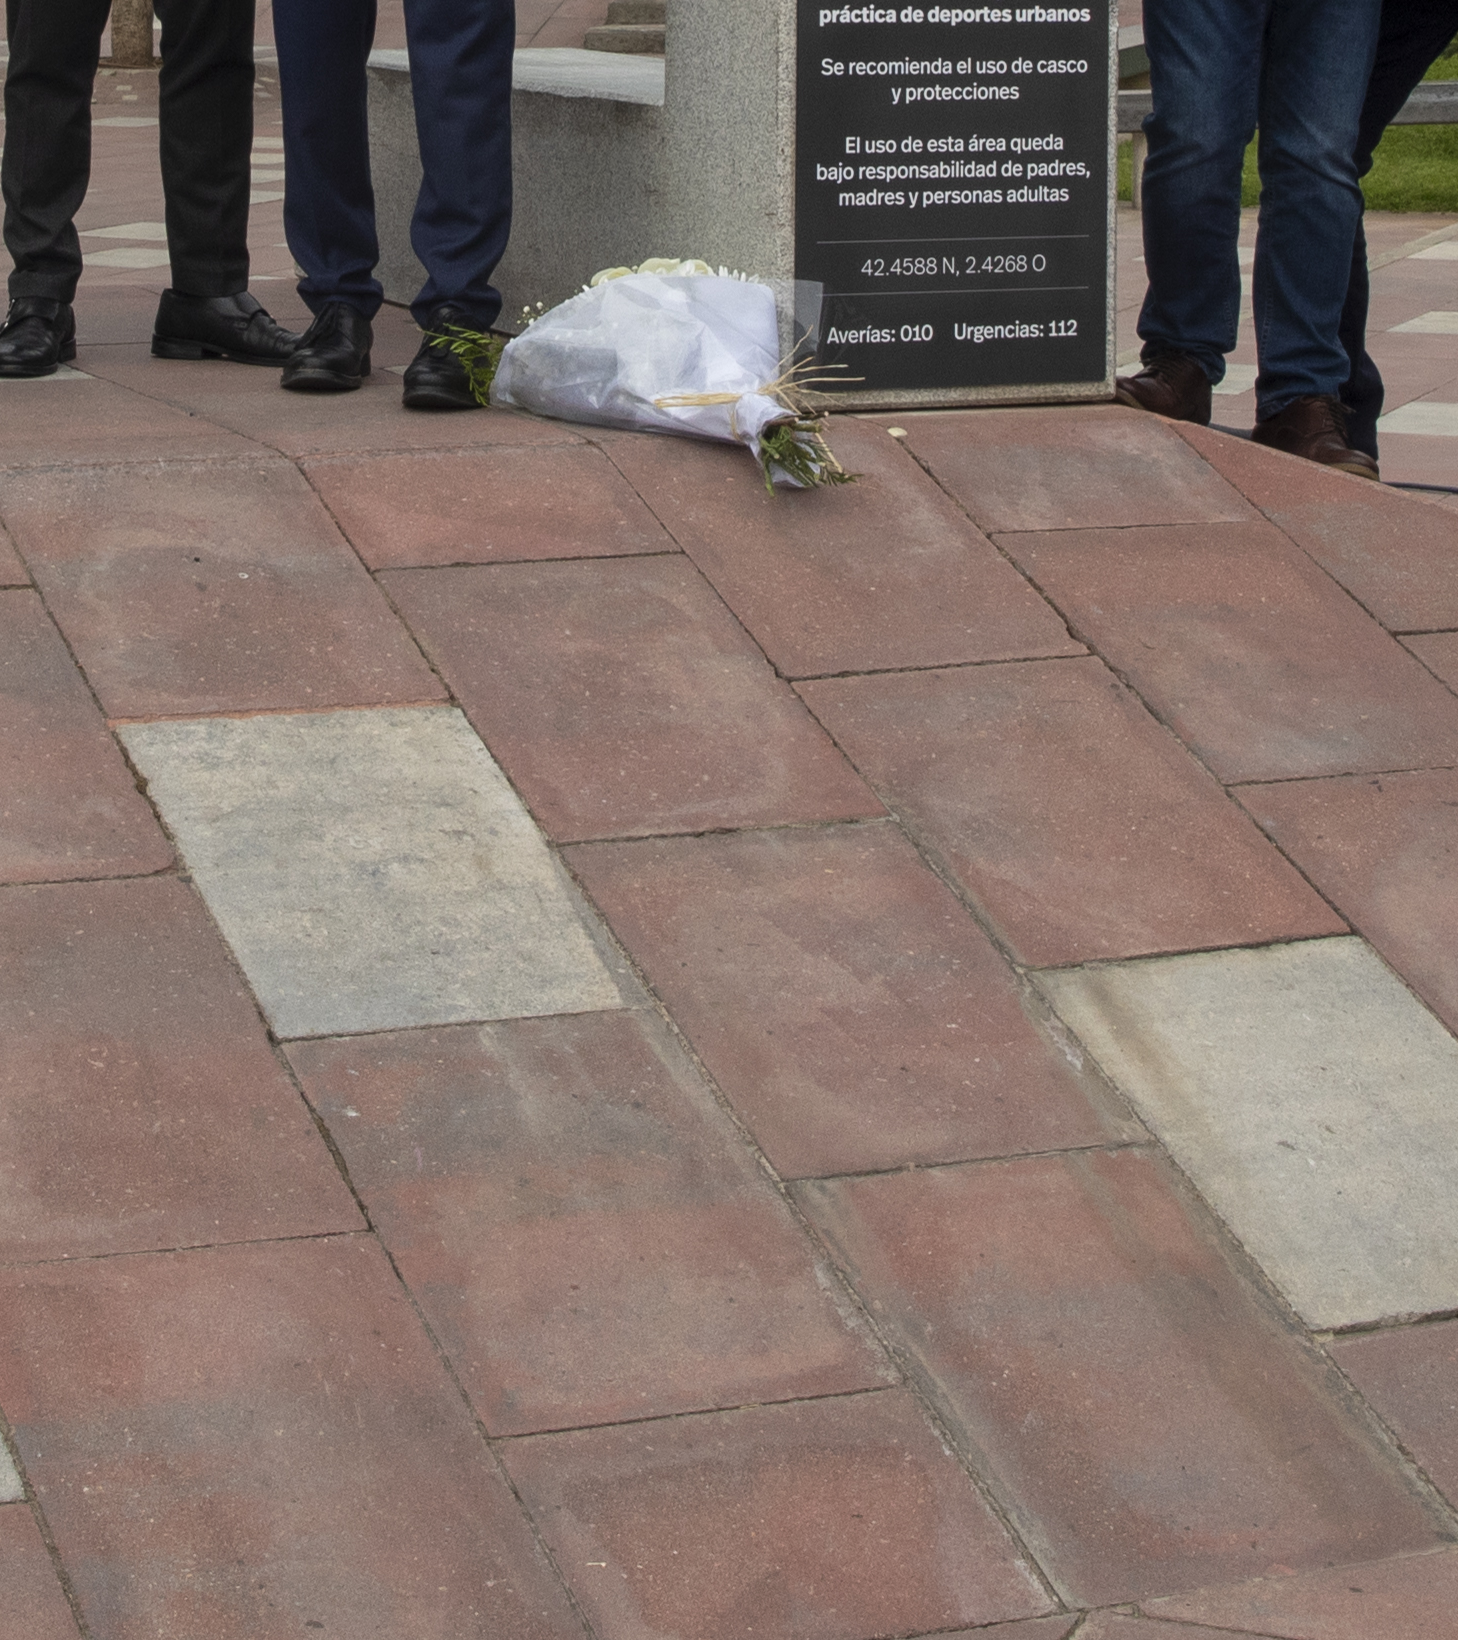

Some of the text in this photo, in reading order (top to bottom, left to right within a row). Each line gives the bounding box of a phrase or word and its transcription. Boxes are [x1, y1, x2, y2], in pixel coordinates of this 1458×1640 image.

[818, 3, 1092, 28] práctica de deportes urbanos
[820, 56, 1089, 77] Se recomienda el uso de casco
[890, 81, 1020, 105] y protecciones
[845, 133, 1064, 155] El uso de esta área queda
[816, 158, 1091, 185] bajo responsabilidad de padres,
[838, 184, 1070, 209] madres y personas adultas
[860, 256, 938, 277] 42.4588
[942, 256, 960, 277] N,
[965, 253, 1028, 274] 2.4268
[826, 318, 1078, 345] Averías: 010 Urgencias: 112
